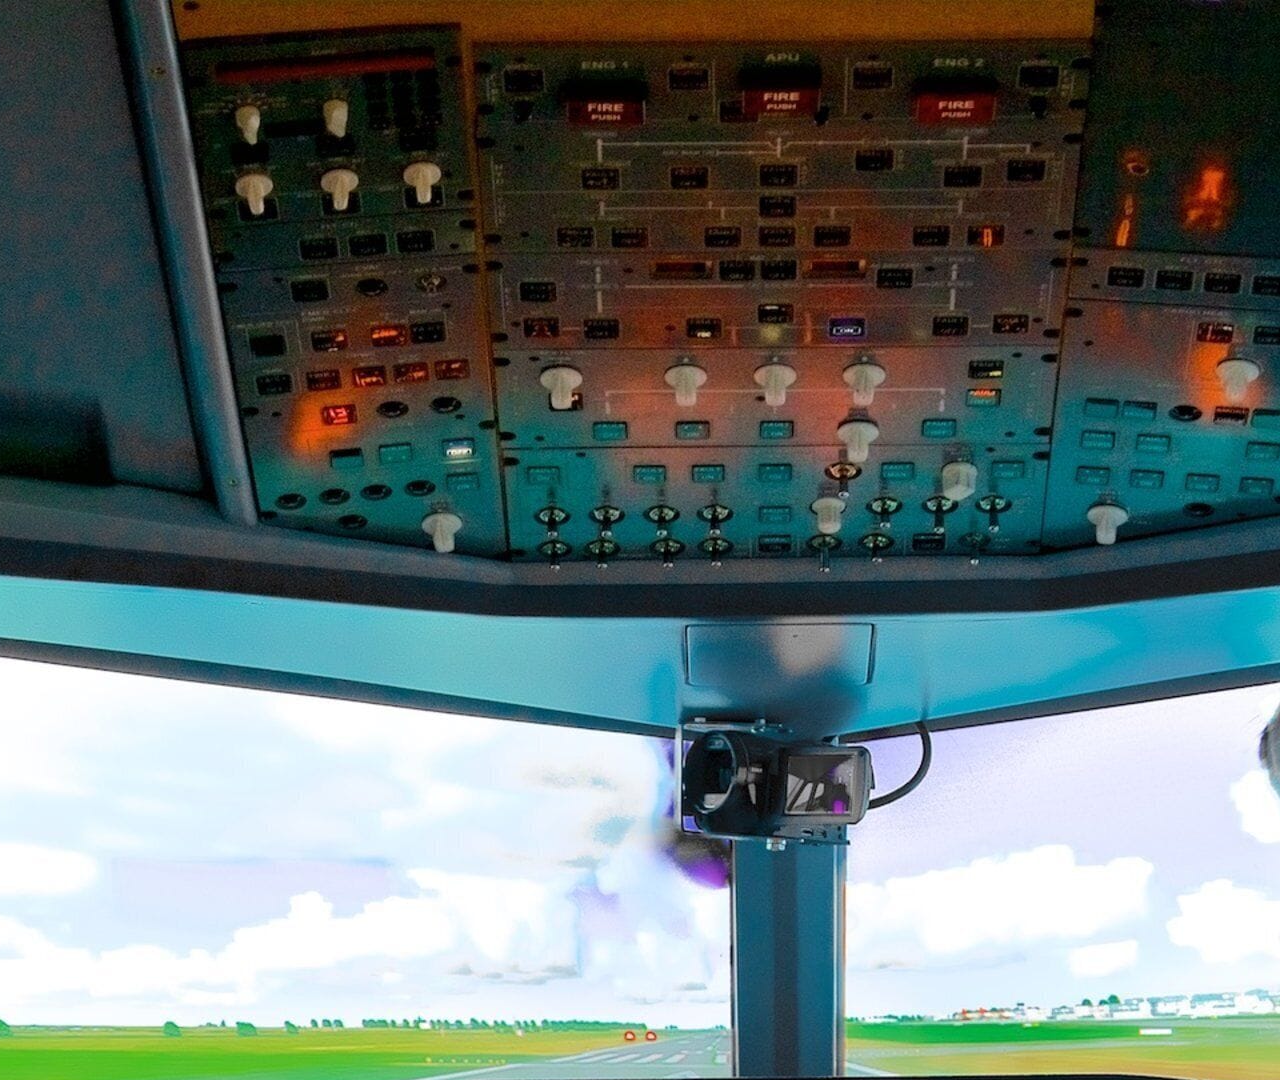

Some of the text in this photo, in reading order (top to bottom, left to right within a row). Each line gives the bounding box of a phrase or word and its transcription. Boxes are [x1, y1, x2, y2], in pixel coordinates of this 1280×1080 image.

[764, 92, 800, 101] FIRE
[588, 103, 624, 112] FIRE
[938, 101, 975, 109] FIRE
